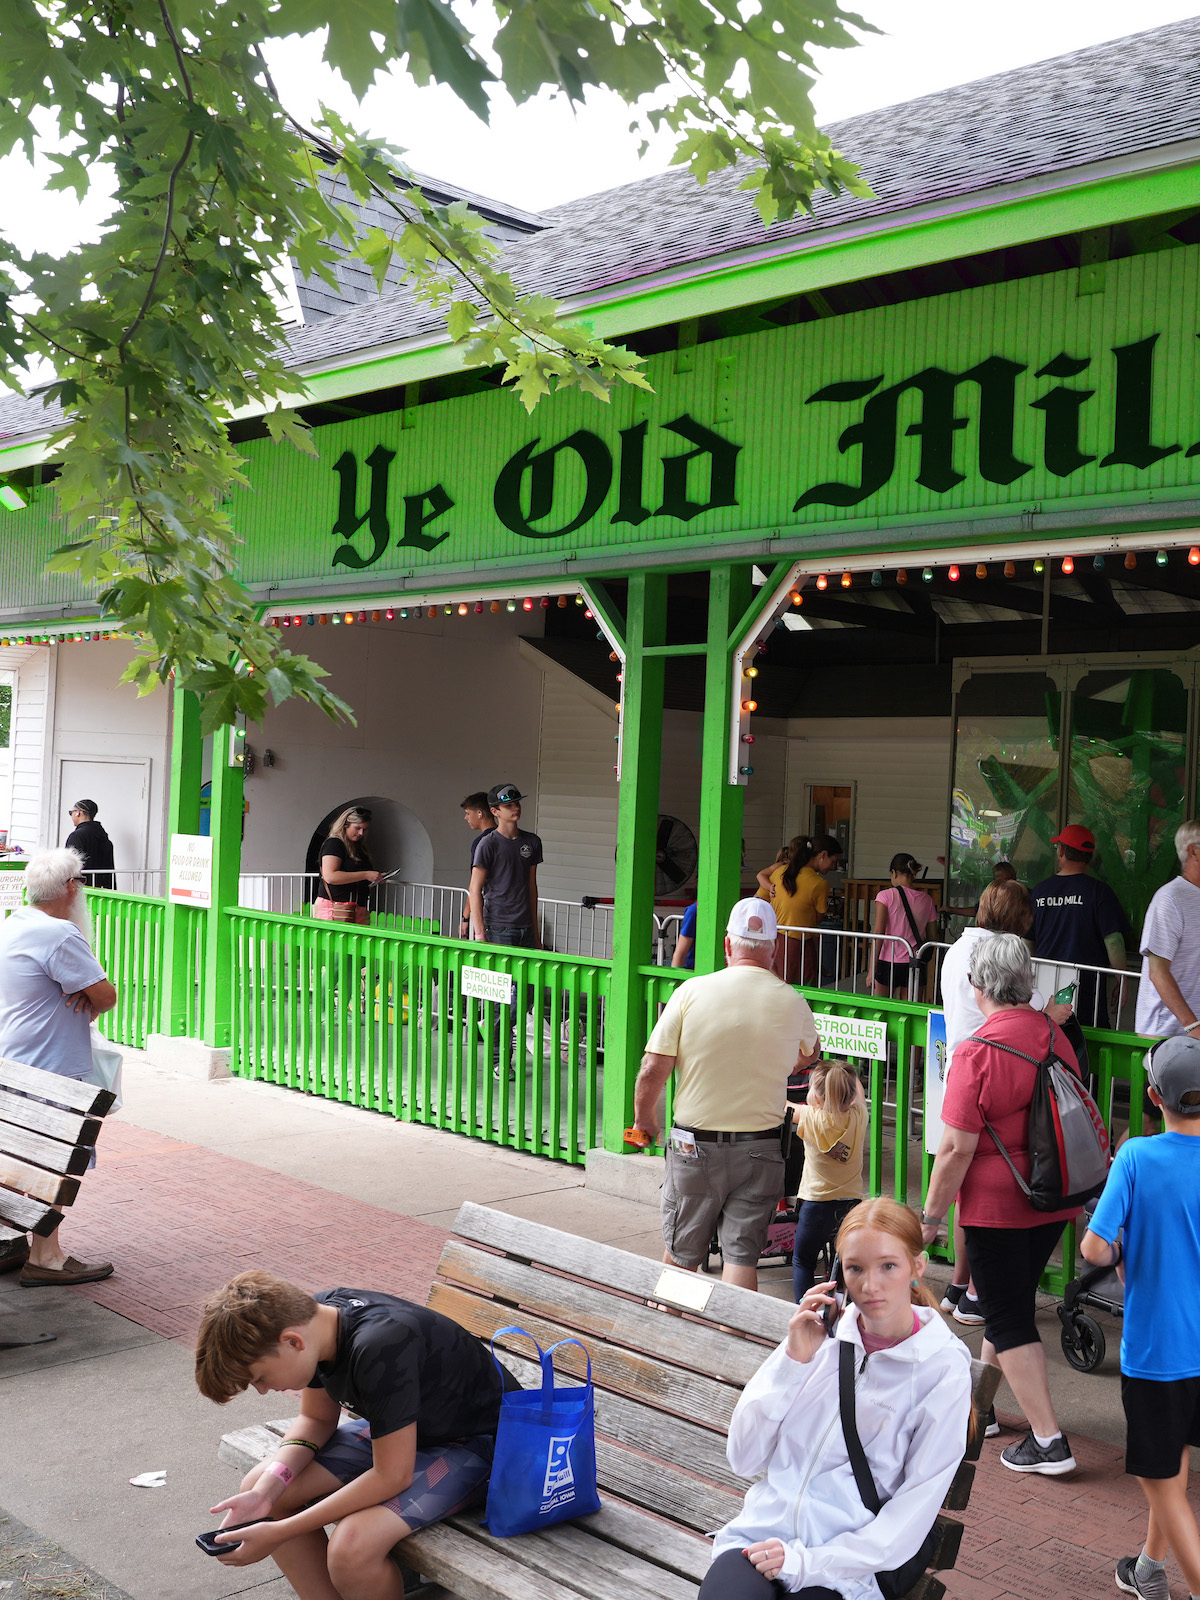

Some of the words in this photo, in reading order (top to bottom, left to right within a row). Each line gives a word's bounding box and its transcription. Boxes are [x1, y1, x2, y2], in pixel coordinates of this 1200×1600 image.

[332, 444, 455, 569] Ye
[493, 413, 743, 539] Old
[1035, 897, 1046, 907] YE
[1047, 896, 1064, 906] OLD
[1064, 895, 1084, 905] MILL
[463, 969, 510, 987] STROLLER
[466, 982, 506, 1000] PARKING
[815, 1018, 883, 1040] STROLLER
[821, 1035, 879, 1054] PARKING
